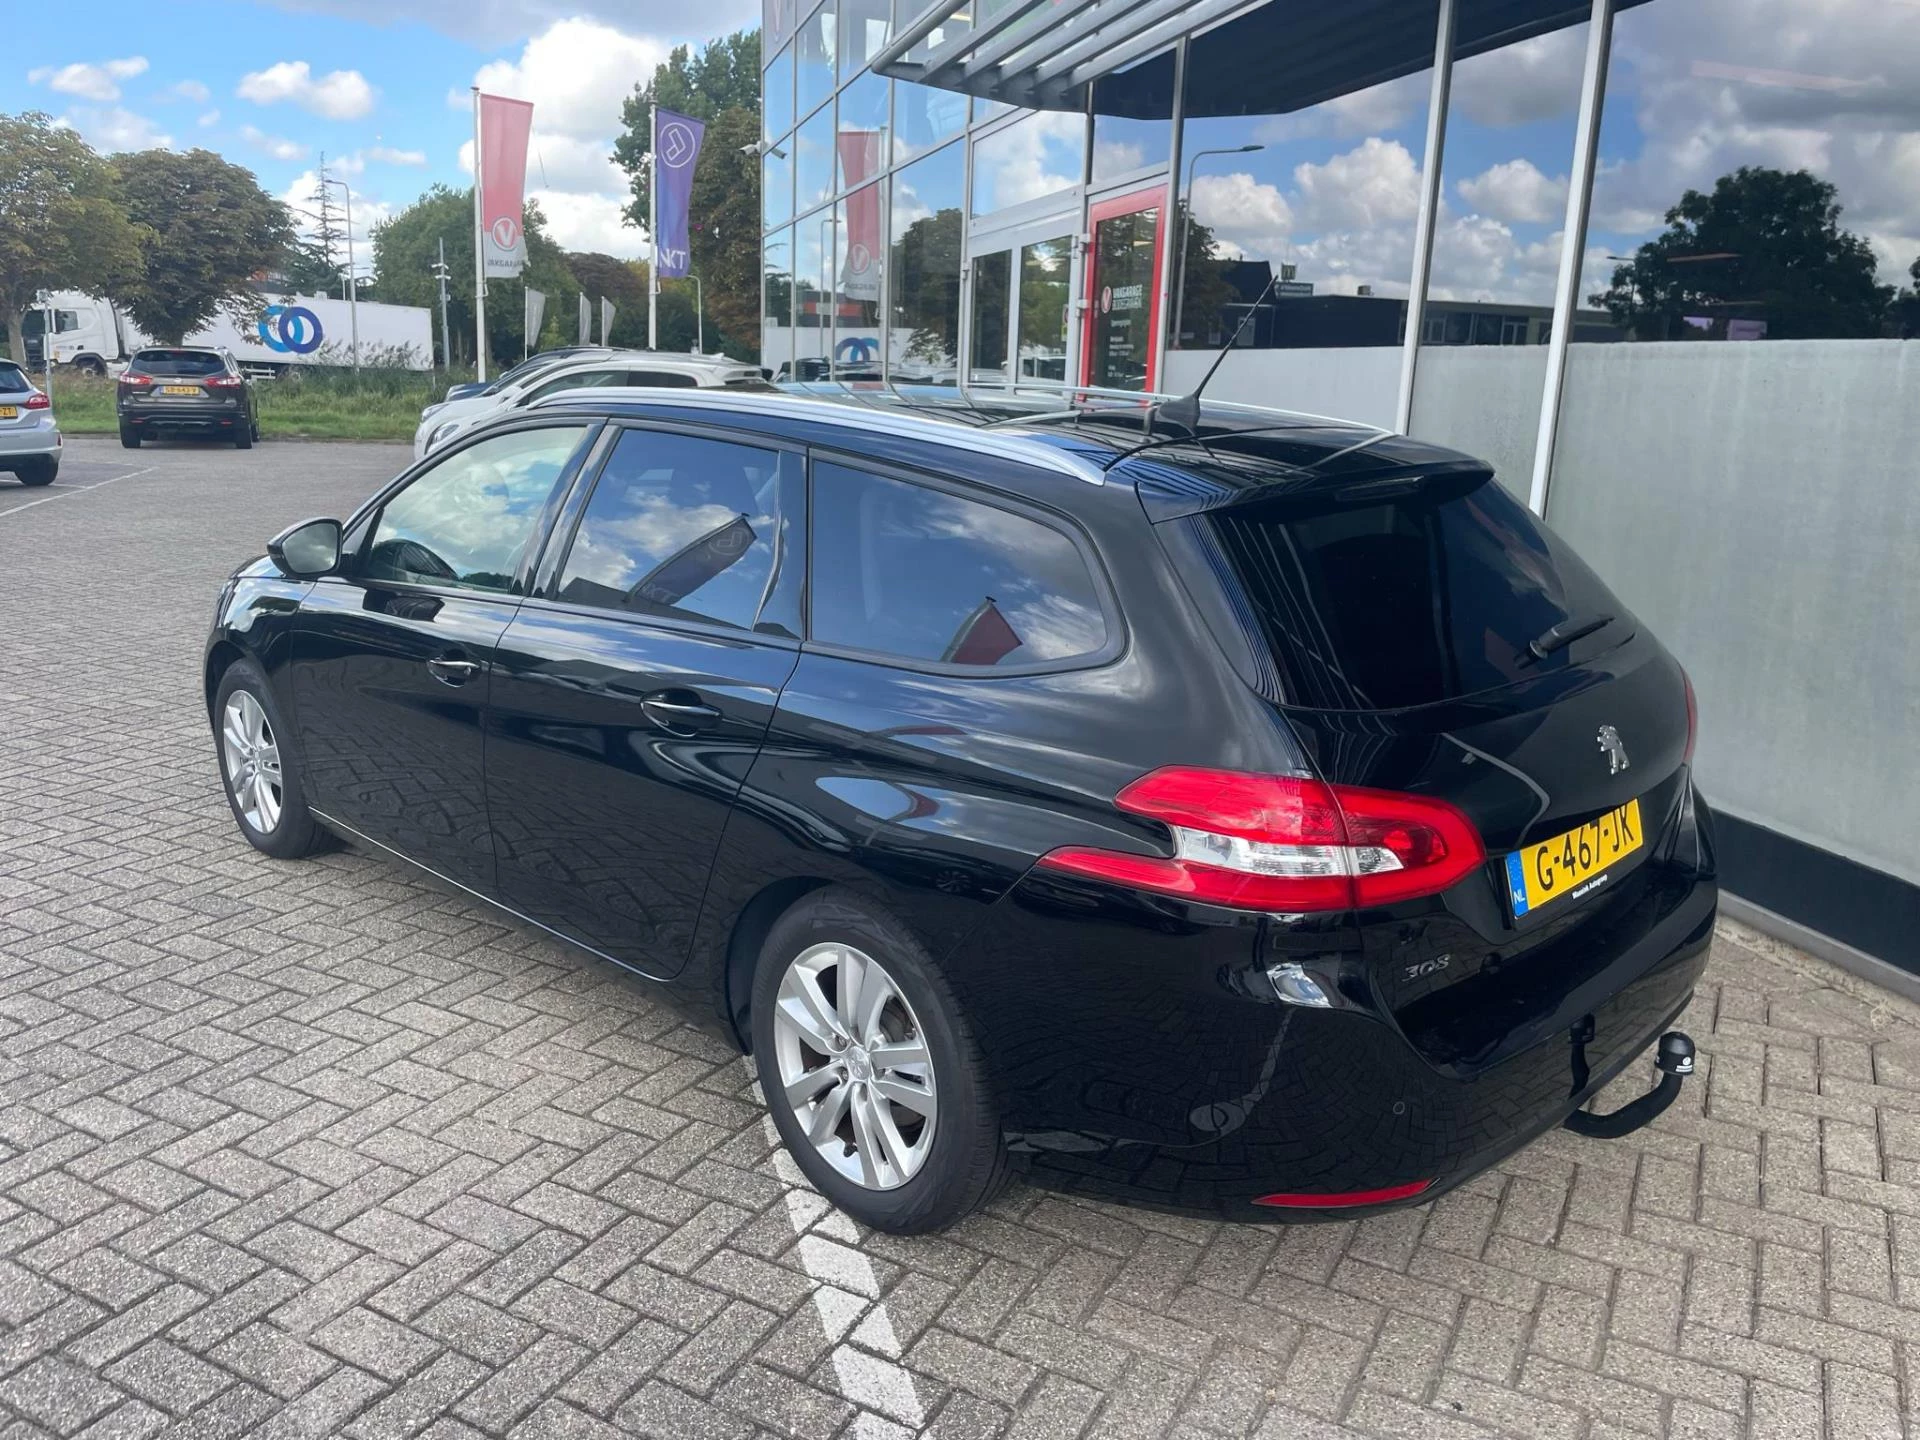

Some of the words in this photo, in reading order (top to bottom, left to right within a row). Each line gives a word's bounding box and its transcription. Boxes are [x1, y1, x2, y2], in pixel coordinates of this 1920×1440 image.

[1536, 804, 1635, 891] G-467-JK
[1513, 889, 1526, 904] NL
[1401, 954, 1451, 981] 308
